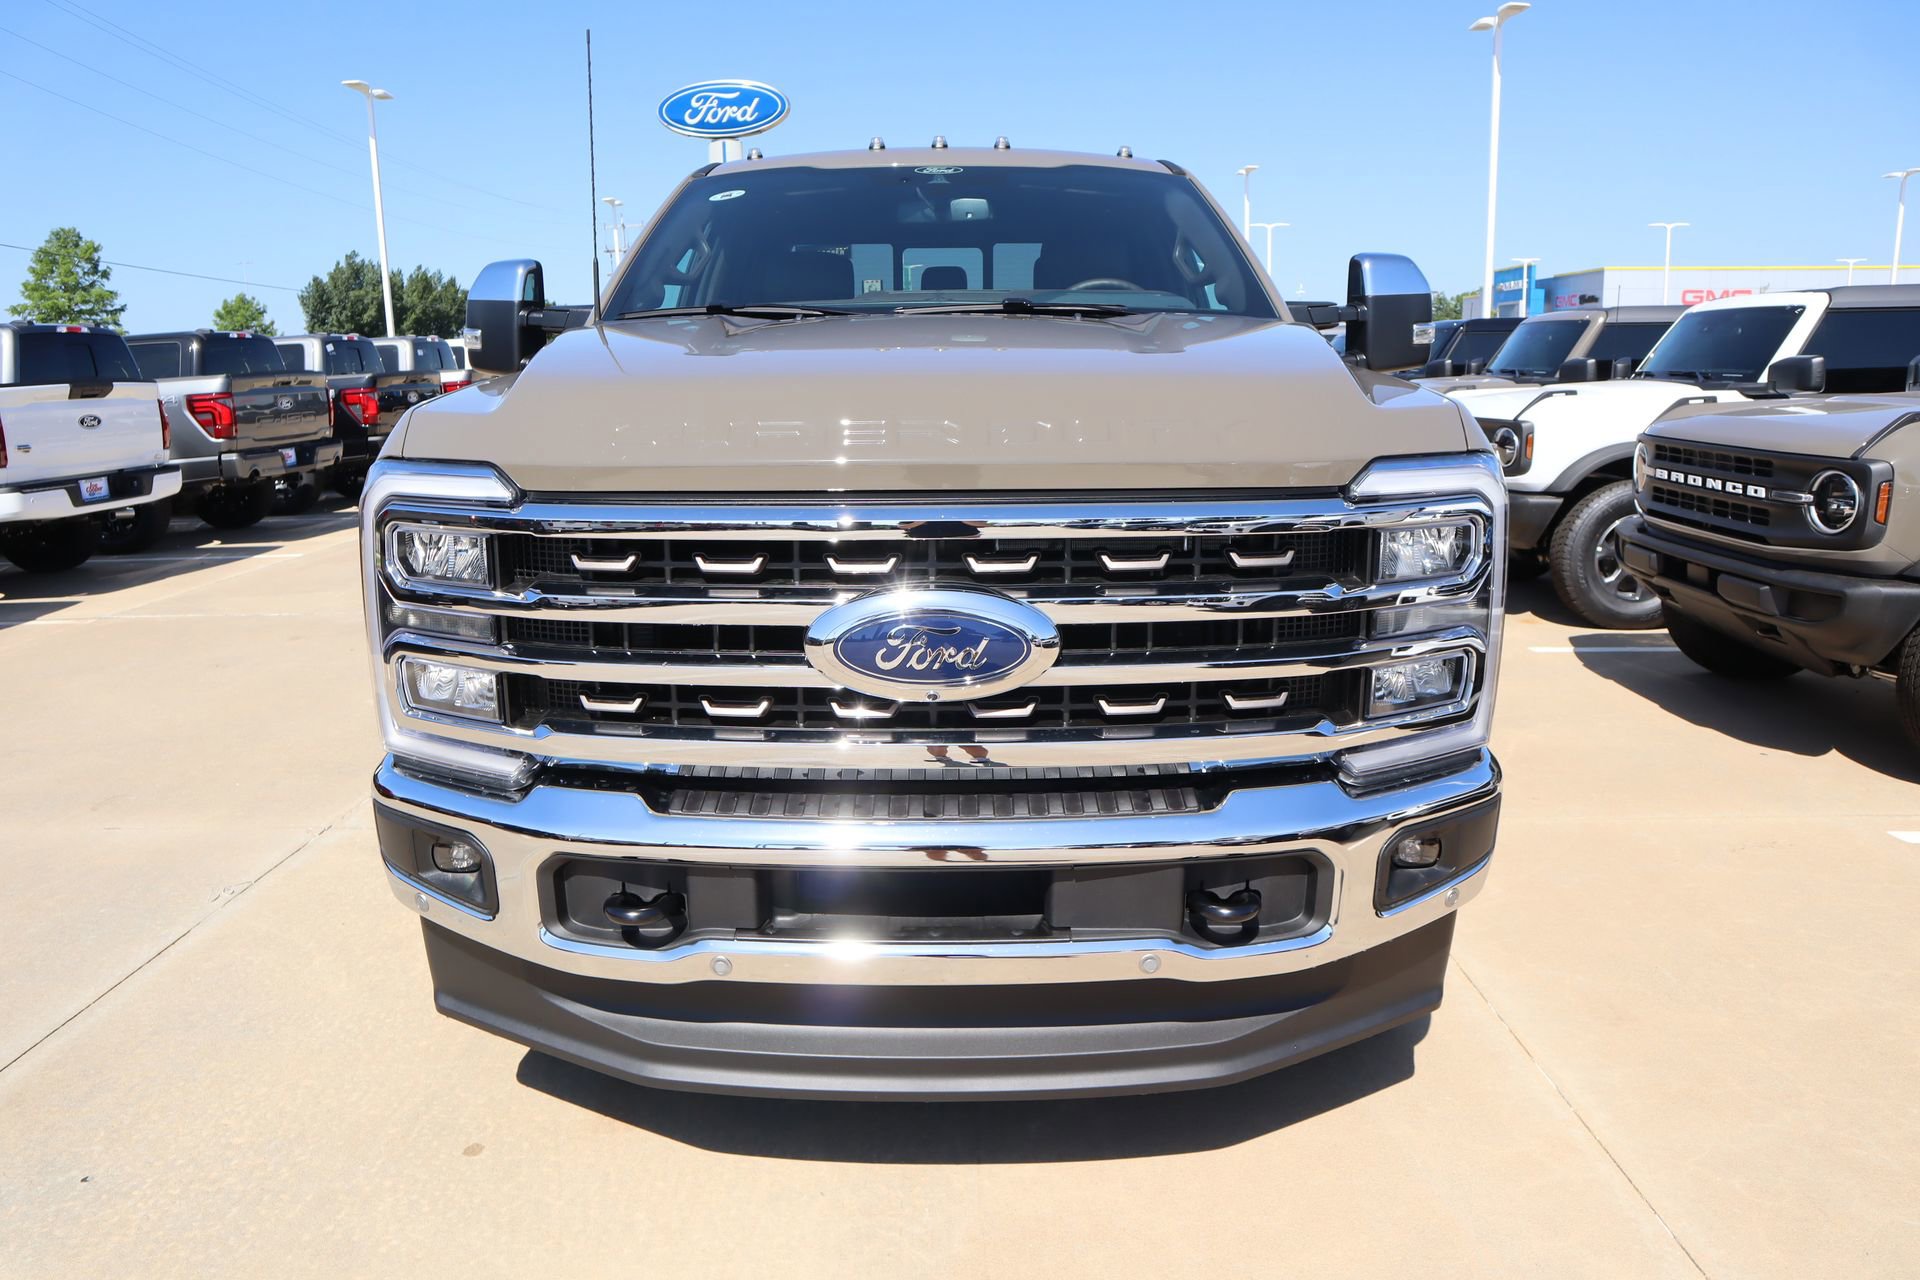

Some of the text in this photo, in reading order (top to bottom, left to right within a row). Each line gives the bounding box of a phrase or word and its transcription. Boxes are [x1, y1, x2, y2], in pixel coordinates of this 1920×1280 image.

[684, 92, 760, 125] Ford
[83, 416, 99, 427] Ford
[1655, 468, 1767, 499] BRONCO
[875, 624, 989, 671] Ford
